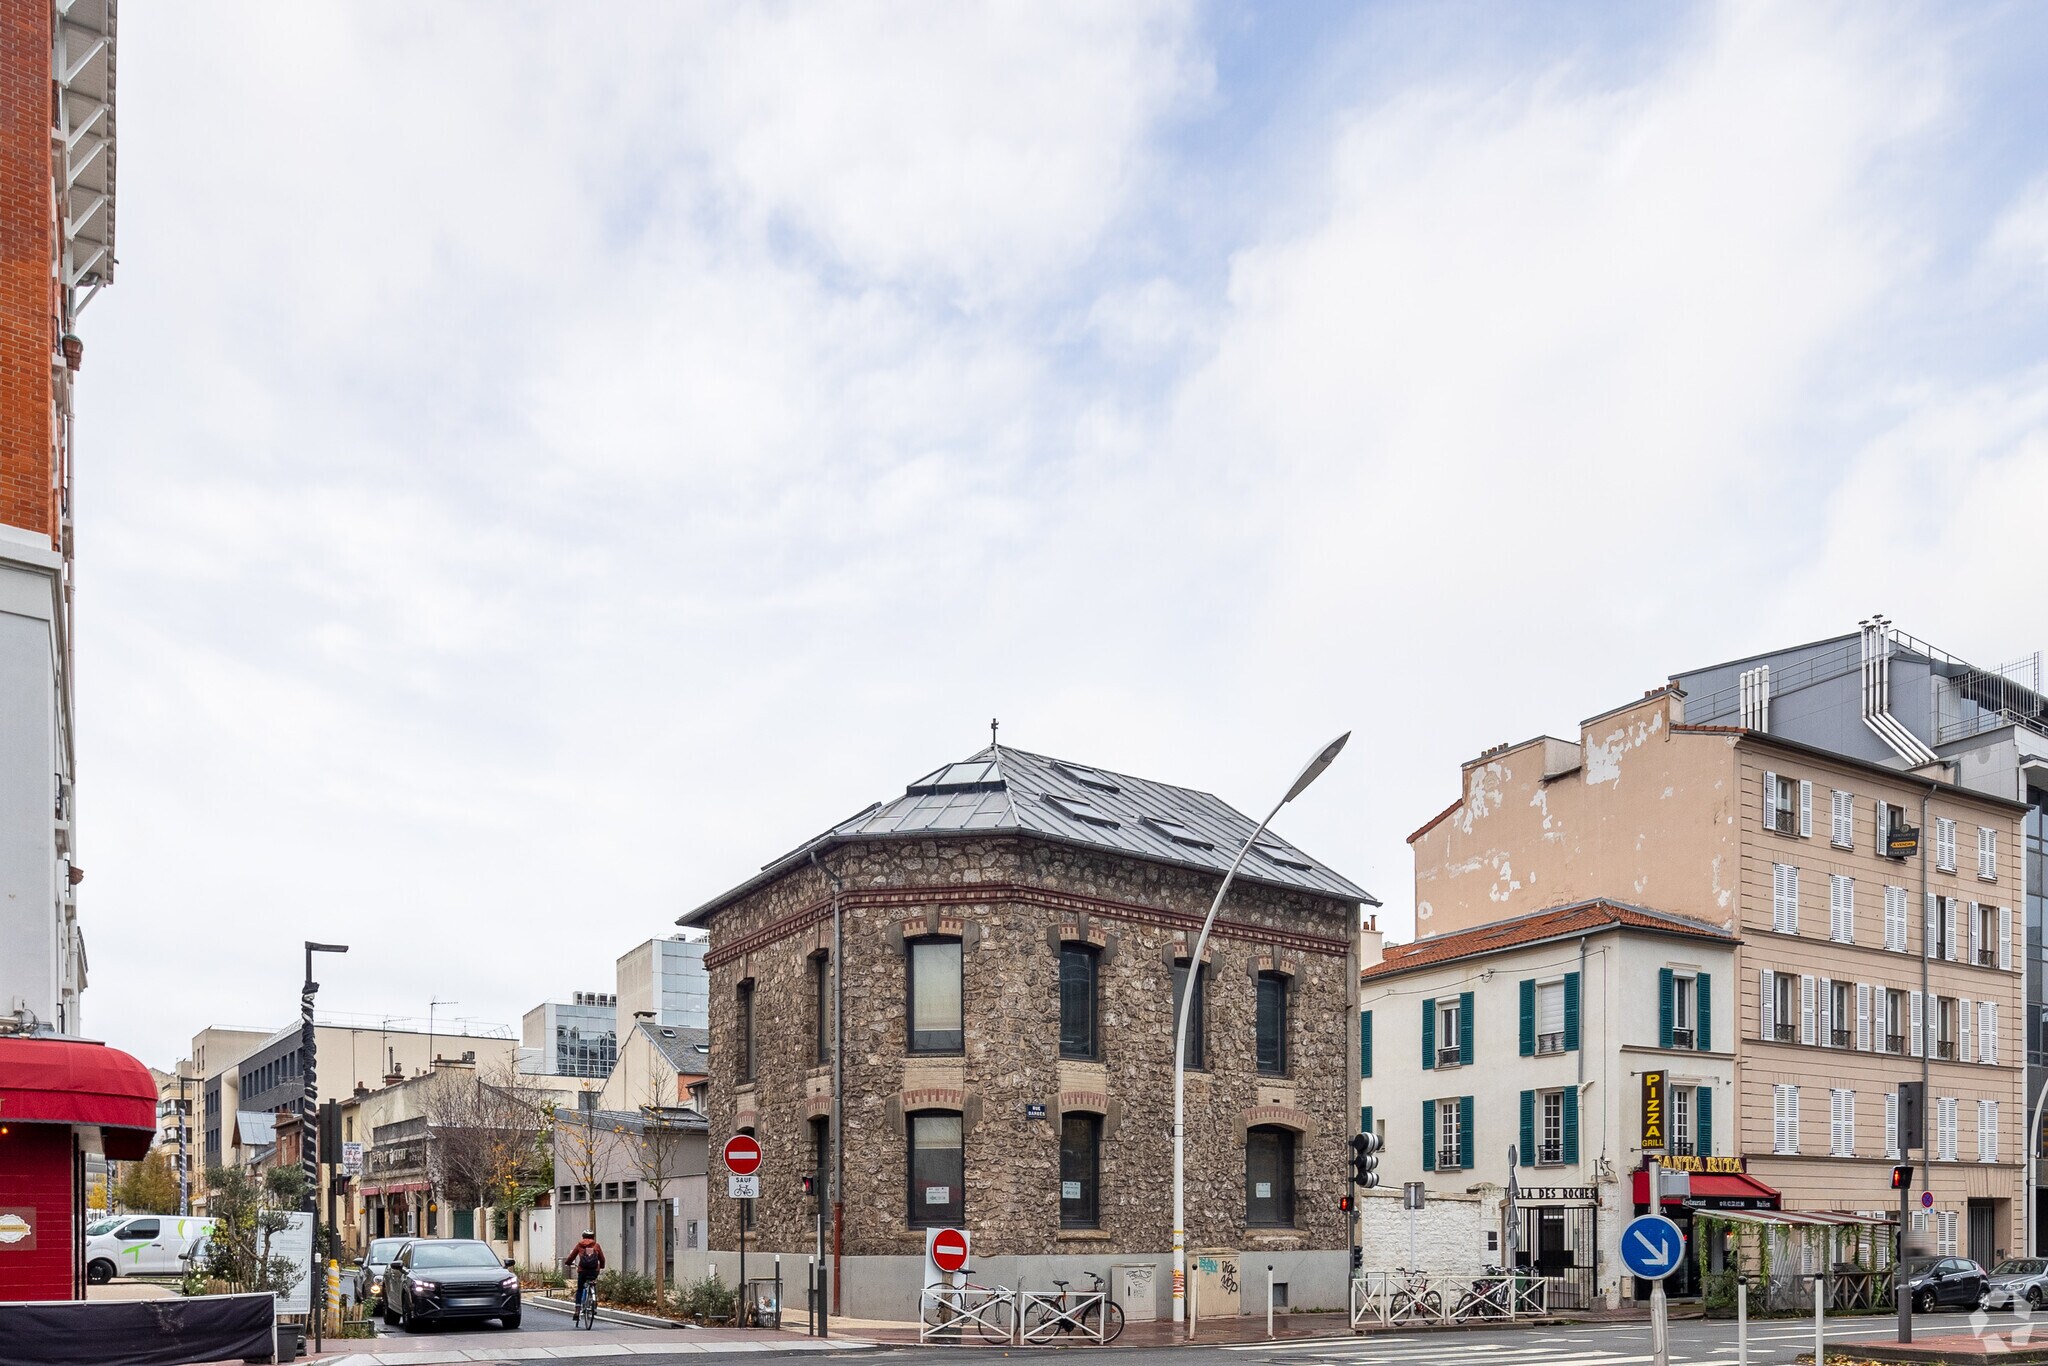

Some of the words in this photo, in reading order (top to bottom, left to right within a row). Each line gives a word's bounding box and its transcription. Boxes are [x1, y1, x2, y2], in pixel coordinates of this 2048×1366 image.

[1646, 1074, 1661, 1137] PIZZA
[1642, 1139, 1664, 1147] GRILL
[1706, 1157, 1744, 1173] RITA
[1540, 1188, 1556, 1199] DES
[1563, 1188, 1596, 1199] ROCHES
